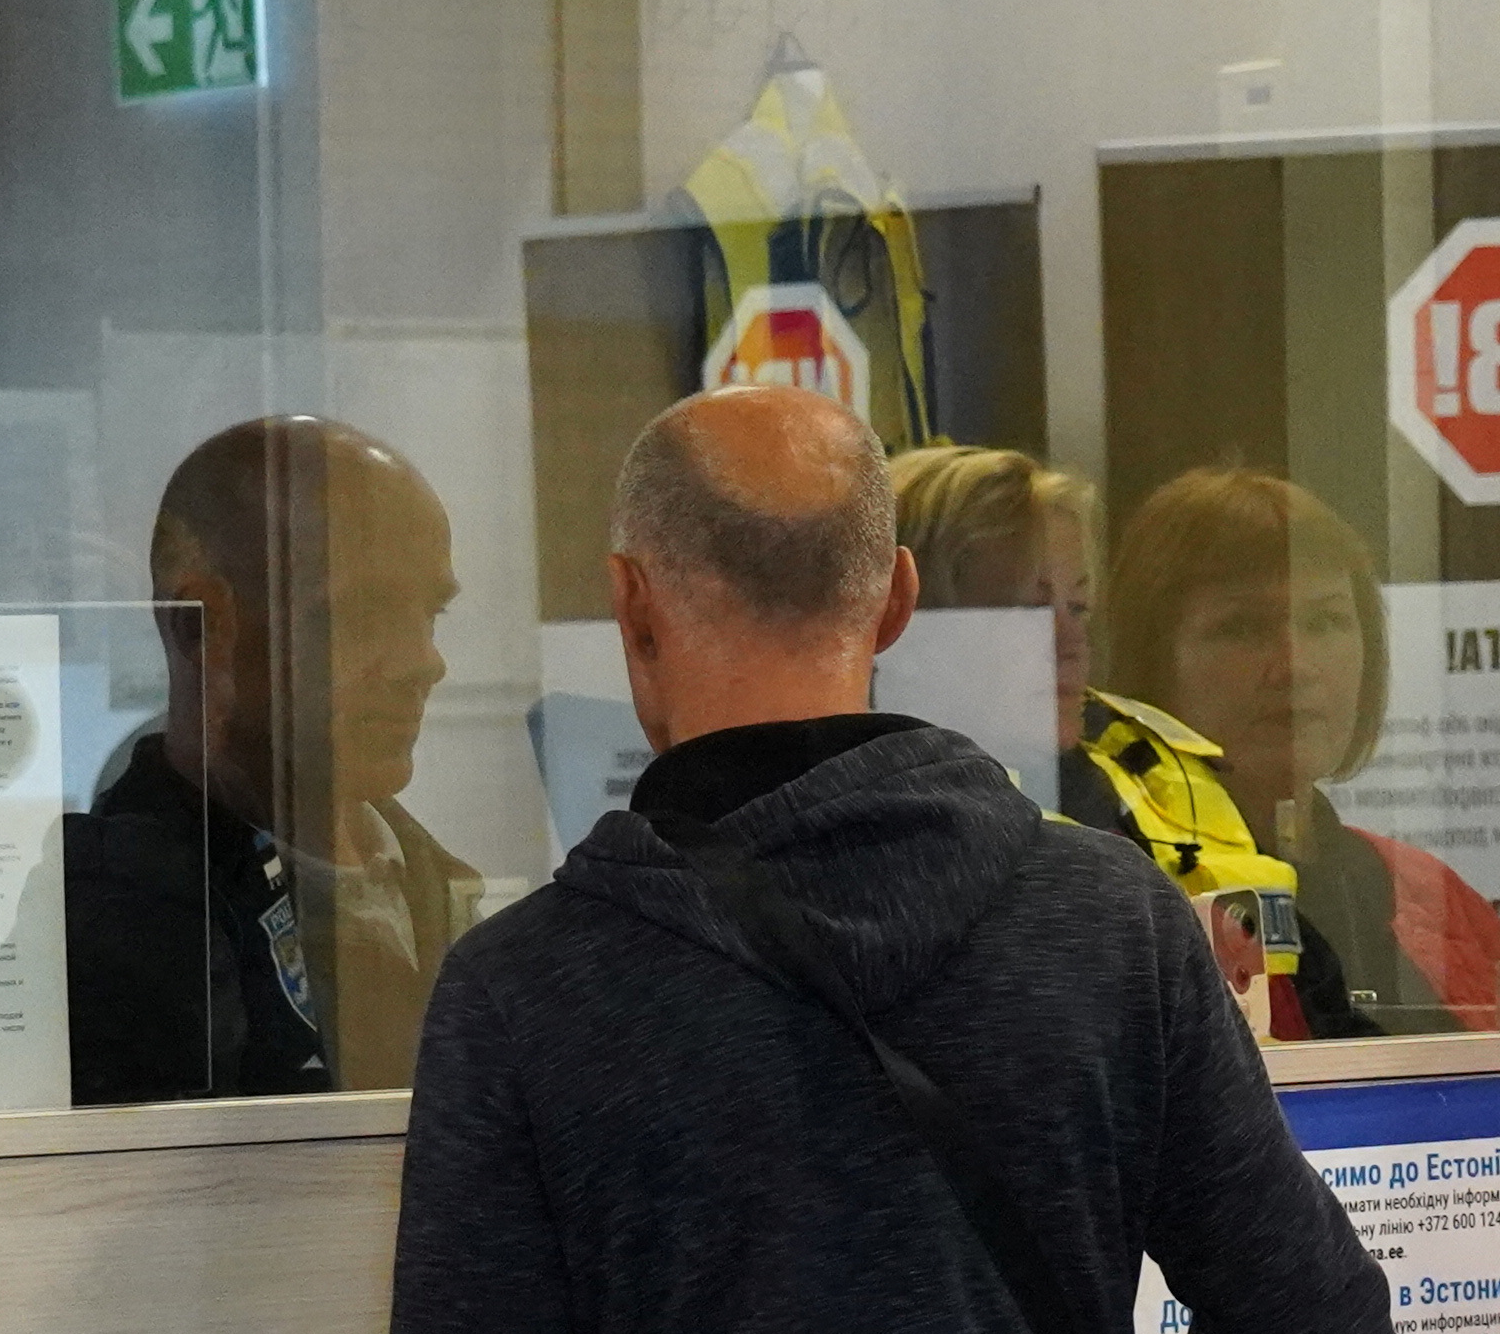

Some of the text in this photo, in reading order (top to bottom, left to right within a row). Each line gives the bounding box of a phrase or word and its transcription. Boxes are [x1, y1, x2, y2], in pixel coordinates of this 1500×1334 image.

[1390, 1161, 1419, 1189] до
[1385, 1192, 1450, 1212] необхідну
[1379, 1218, 1414, 1236] лінію
[1418, 1216, 1449, 1233] +372
[1452, 1213, 1476, 1230] 600
[1399, 1285, 1412, 1306] в
